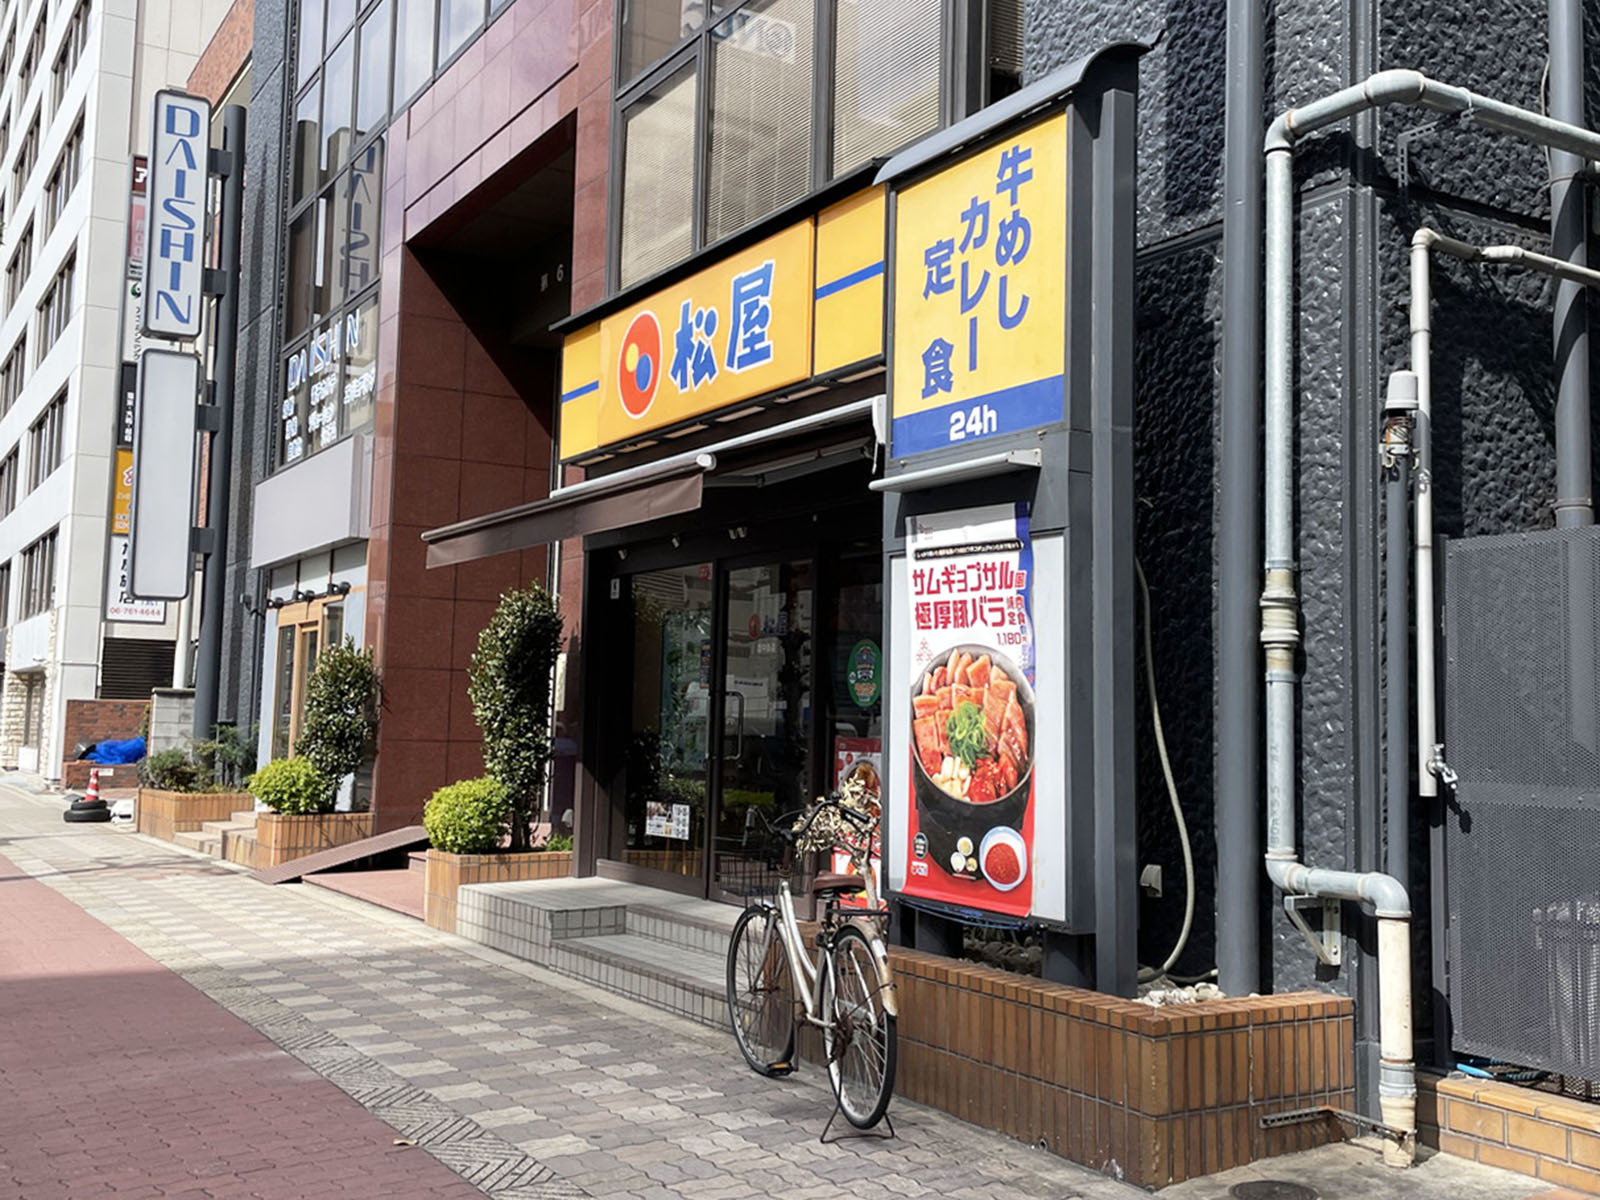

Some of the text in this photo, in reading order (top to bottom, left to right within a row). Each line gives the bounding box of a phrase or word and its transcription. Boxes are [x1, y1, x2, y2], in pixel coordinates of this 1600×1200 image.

[155, 104, 200, 324] DAISHIN
[958, 195, 991, 372] カレー
[995, 144, 1034, 331] 牛めし
[668, 259, 776, 394] 松屋
[921, 237, 955, 399] 定食
[949, 404, 998, 441] 24h
